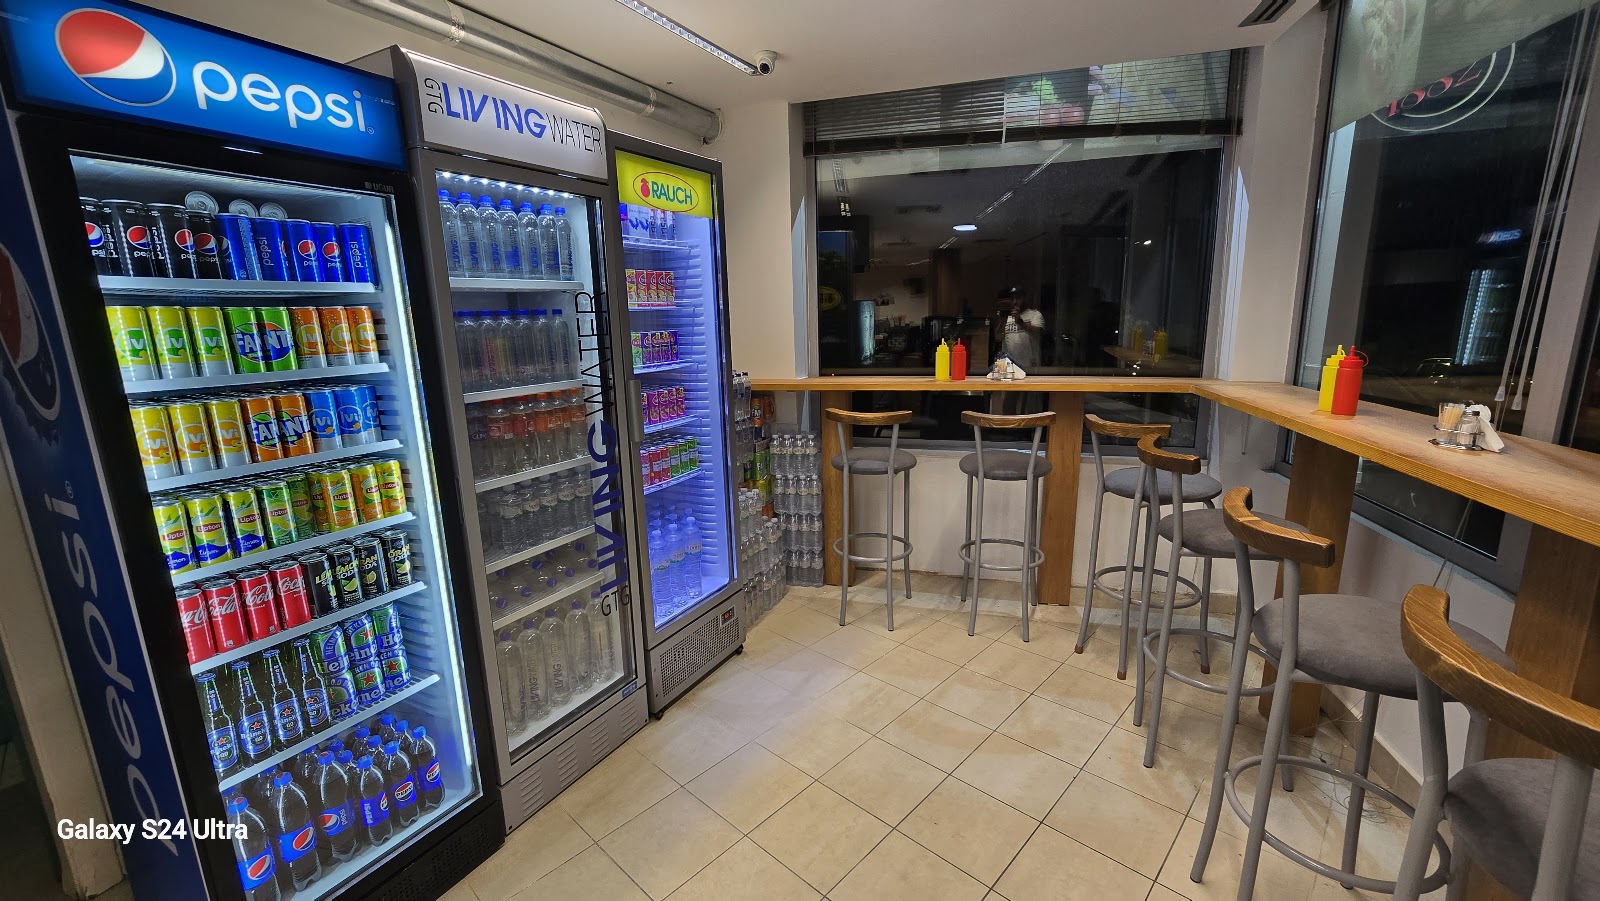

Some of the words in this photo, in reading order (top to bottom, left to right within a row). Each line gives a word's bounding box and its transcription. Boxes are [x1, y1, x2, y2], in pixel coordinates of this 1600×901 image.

[192, 61, 366, 132] pepsi
[424, 77, 444, 115] GTG
[441, 81, 548, 139] LIVING
[545, 112, 604, 155] WATER
[651, 180, 694, 206] RAUCH
[257, 237, 275, 266] pepsi
[350, 241, 364, 269] pepsi
[587, 419, 628, 595] LIVING
[600, 584, 630, 617] GTG
[45, 490, 179, 857] pepsi
